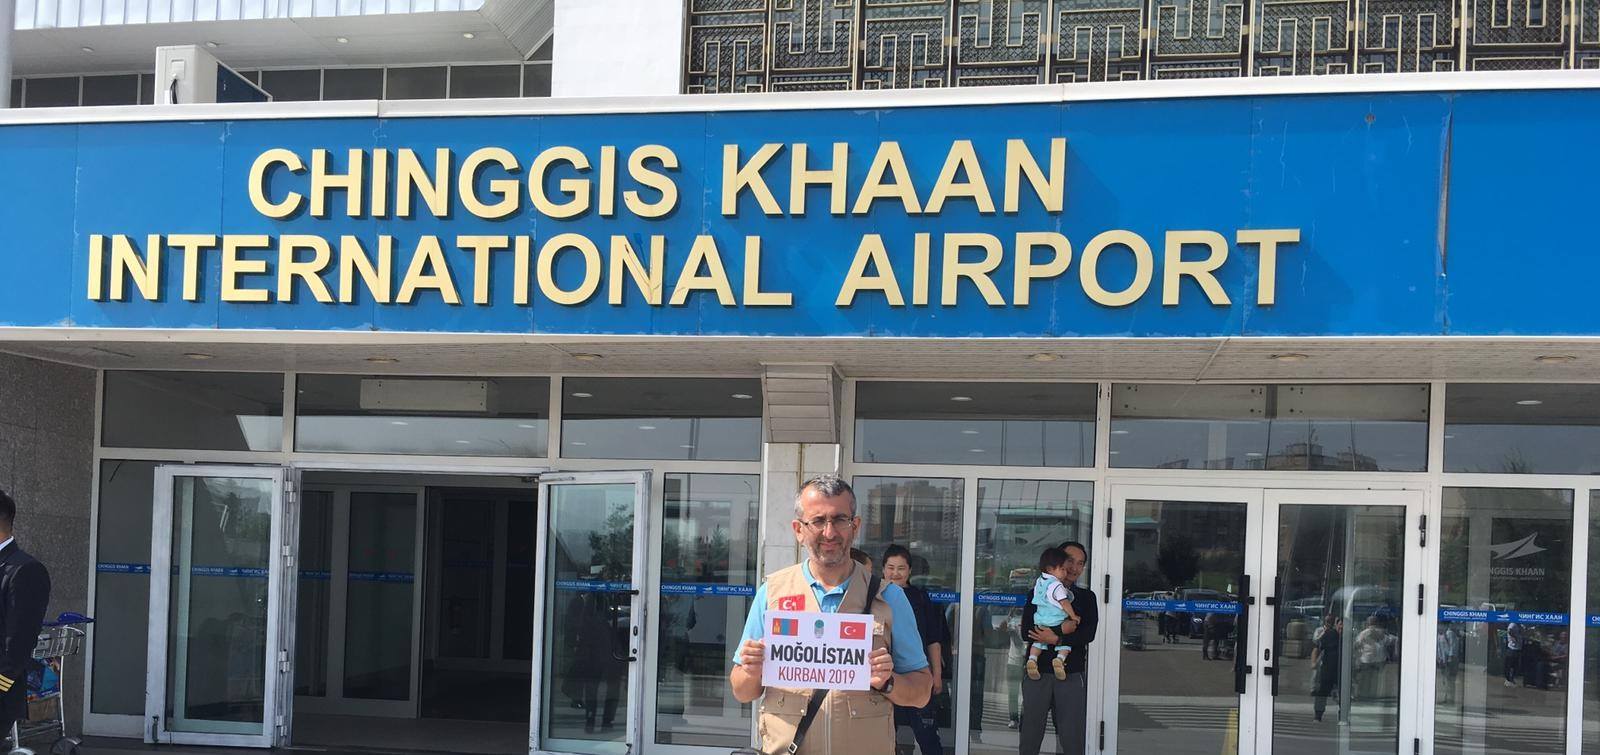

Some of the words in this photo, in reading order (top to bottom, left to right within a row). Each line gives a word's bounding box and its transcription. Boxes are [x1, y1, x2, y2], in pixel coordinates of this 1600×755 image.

[250, 146, 677, 218] CHINGGIS
[723, 139, 1065, 214] KHAAN
[89, 234, 791, 305] INTERNATIONAL
[837, 231, 1299, 305] AIRPORT
[1516, 568, 1545, 576] KHAAN
[770, 641, 865, 665] MOĞOLİSTAN
[778, 666, 826, 683] KURBAN
[828, 669, 856, 684] 2019
